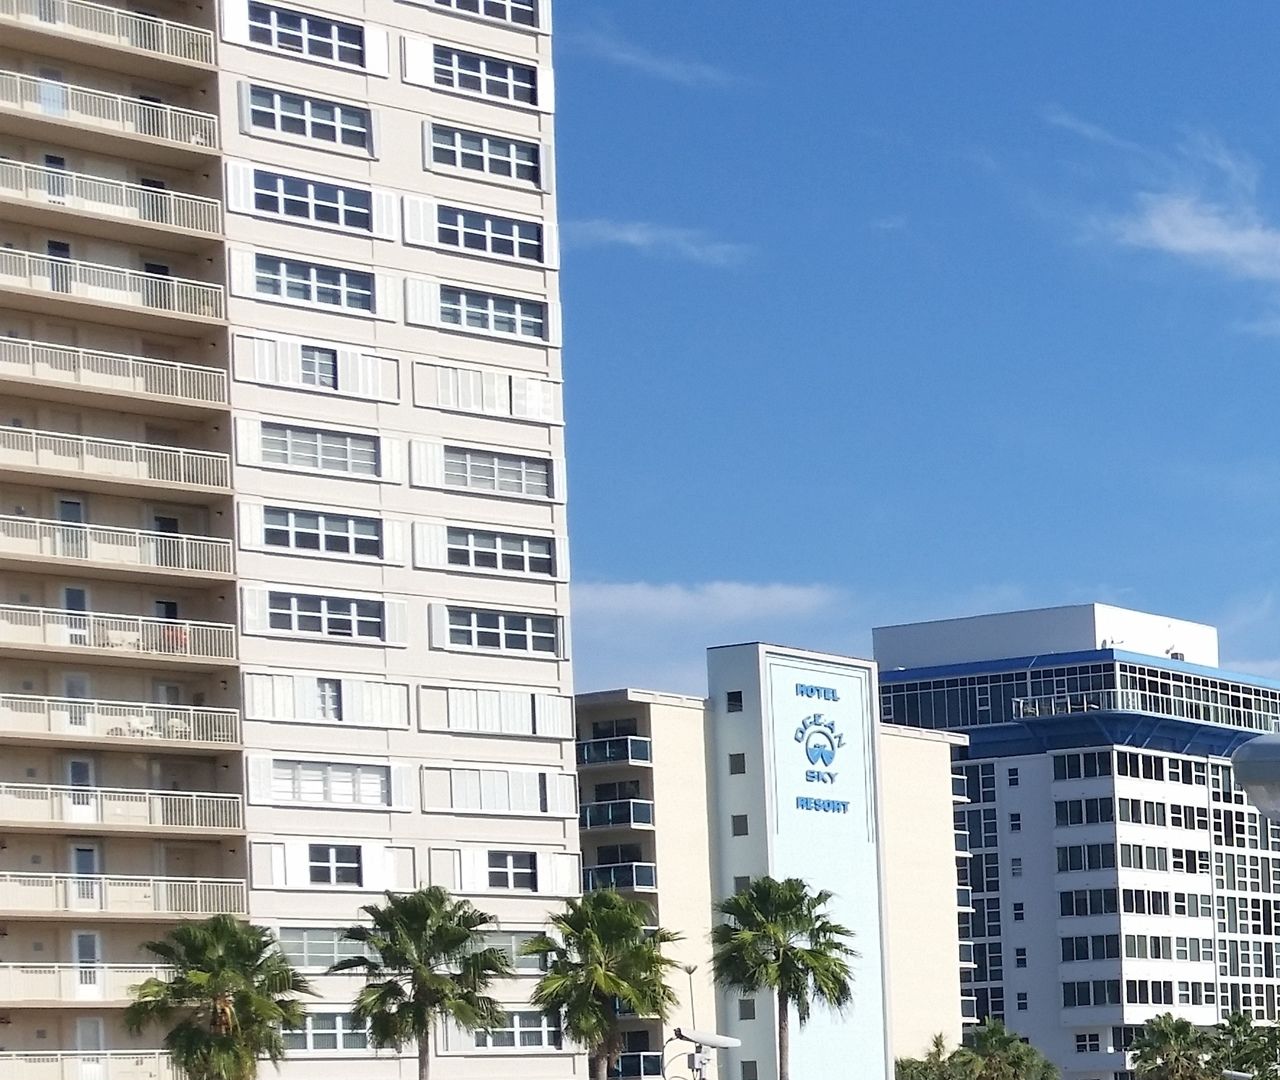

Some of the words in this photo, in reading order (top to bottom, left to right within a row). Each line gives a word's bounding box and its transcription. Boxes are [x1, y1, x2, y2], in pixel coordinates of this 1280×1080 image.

[796, 683, 840, 702] HOTEL
[794, 713, 846, 748] OCEAN
[805, 770, 838, 784] SKY
[796, 796, 850, 814] RESORT
